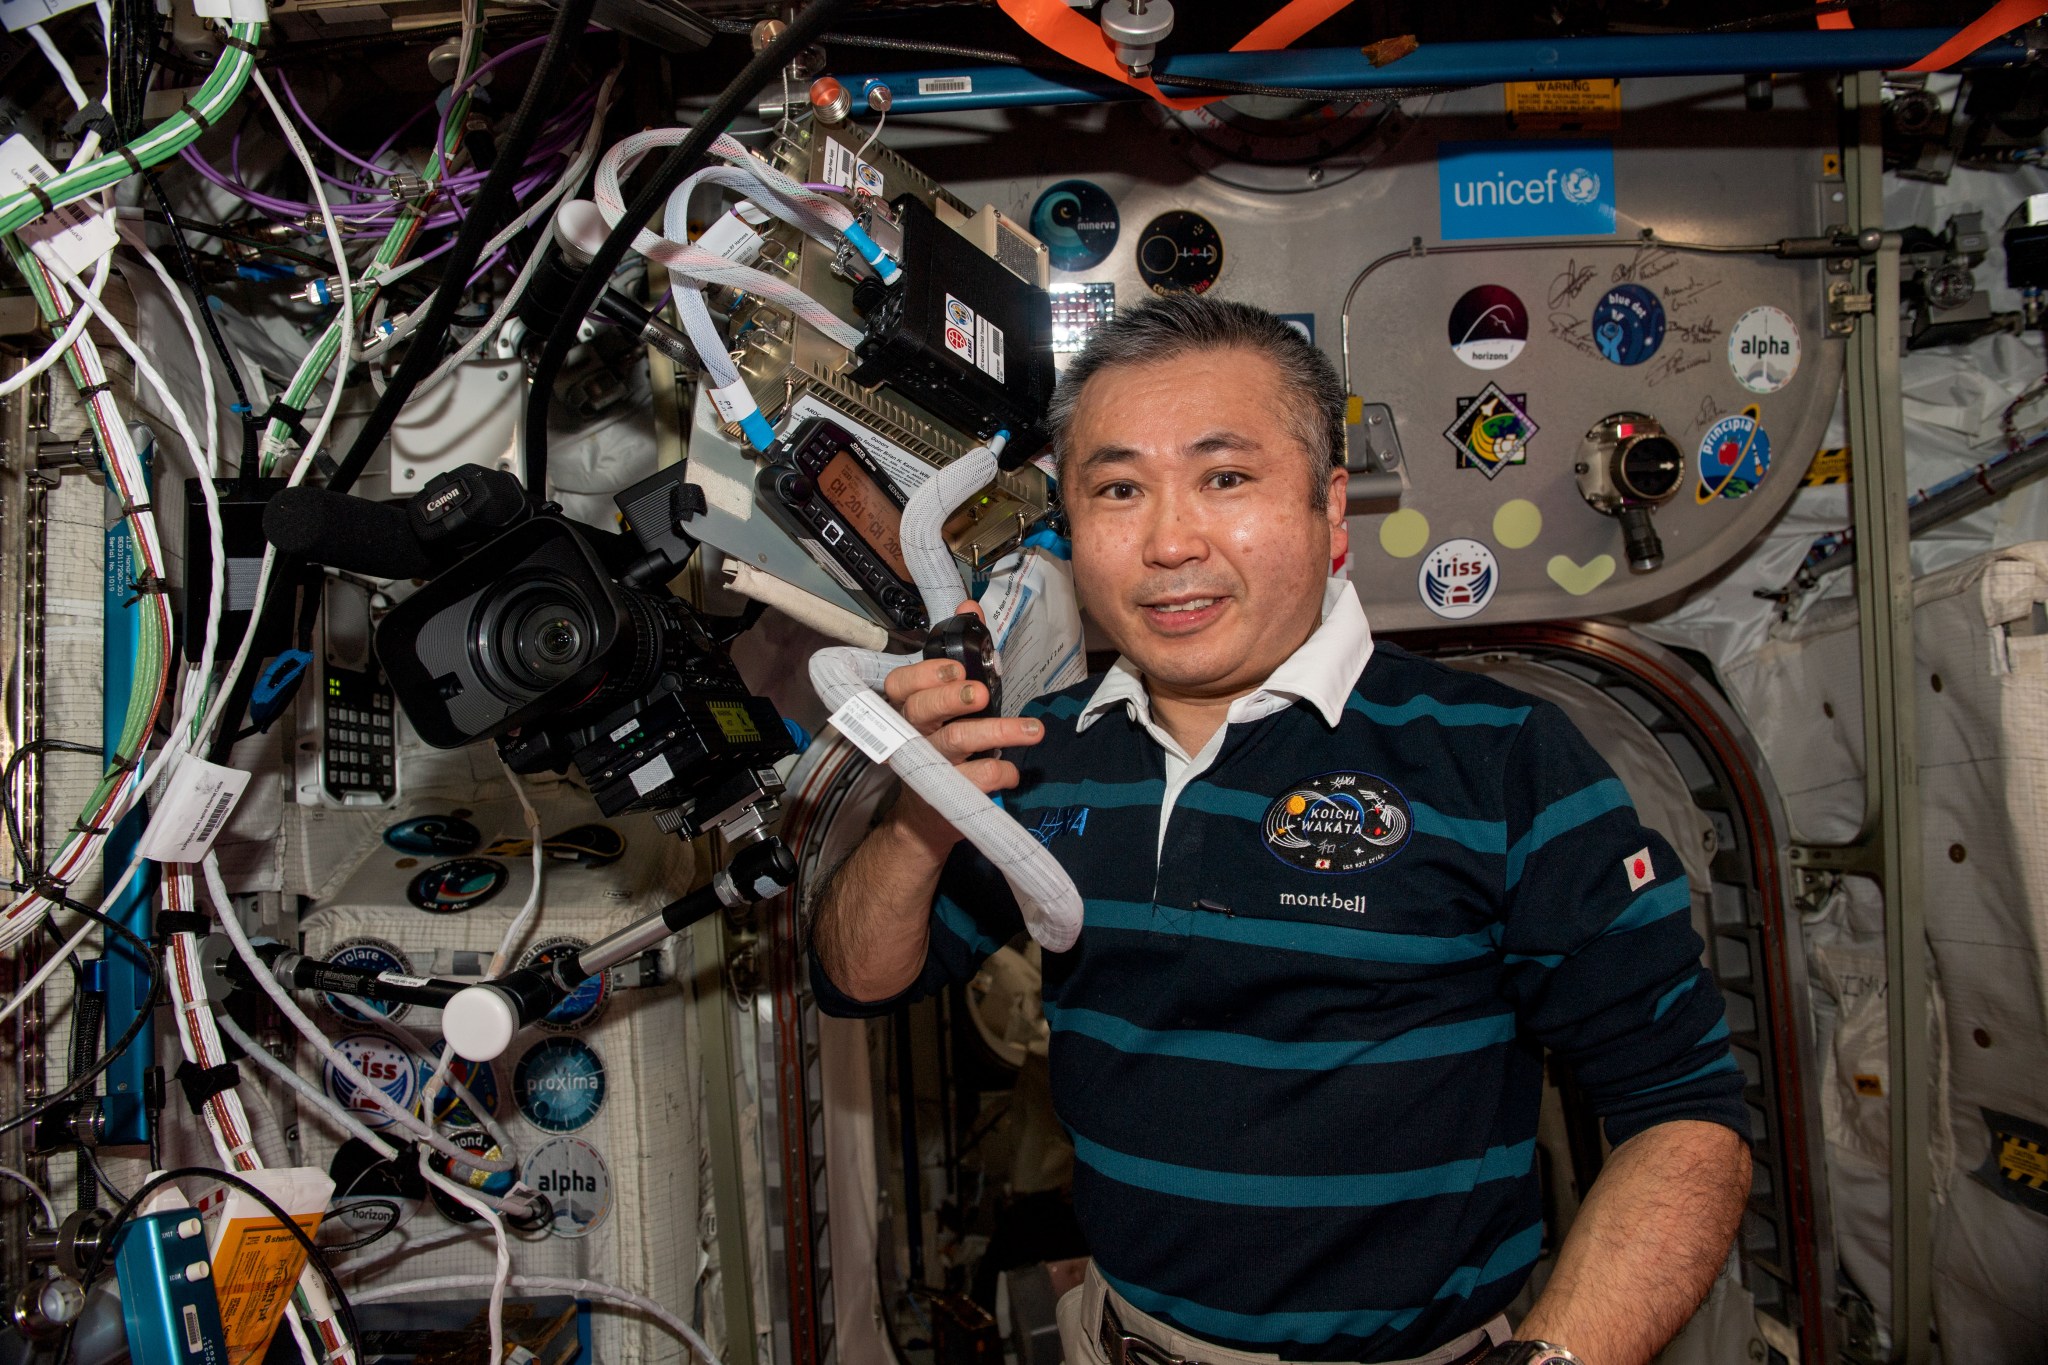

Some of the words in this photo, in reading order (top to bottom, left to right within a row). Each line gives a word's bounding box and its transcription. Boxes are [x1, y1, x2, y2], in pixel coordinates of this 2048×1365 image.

[1536, 82, 1590, 92] WARNING
[1454, 168, 1558, 208] unicef
[1077, 221, 1116, 231] minerva
[1609, 293, 1630, 307] blue
[1632, 301, 1647, 319] dot
[1472, 351, 1508, 361] horizons
[1741, 335, 1789, 359] alpha
[870, 435, 889, 448] Donors
[977, 430, 988, 439] MIC
[1702, 417, 1753, 455] principia
[863, 439, 883, 453] founder
[882, 450, 896, 460] Brian
[426, 488, 460, 512] Canon
[830, 478, 847, 498] CH
[846, 496, 866, 519] 201
[888, 483, 909, 507] KENWOO
[869, 521, 886, 541] CH
[883, 538, 902, 560] 202
[1437, 558, 1481, 577] iriss
[991, 610, 1001, 620] ISS
[996, 599, 1006, 611] Ham
[1331, 776, 1357, 789] JAXA
[191, 821, 201, 832] Rack
[197, 807, 209, 822] Laptop
[204, 791, 218, 808] Ethernet
[214, 780, 224, 792] Cable
[1310, 807, 1360, 821] KOICHI
[1302, 820, 1361, 835] WAKATA
[1317, 839, 1336, 855] 和
[451, 901, 470, 910] ASC
[337, 948, 380, 966] volare
[526, 1071, 599, 1096] proxima
[538, 1169, 597, 1197] alpha
[264, 1235, 271, 1243] 8
[271, 1234, 295, 1243] sheets
